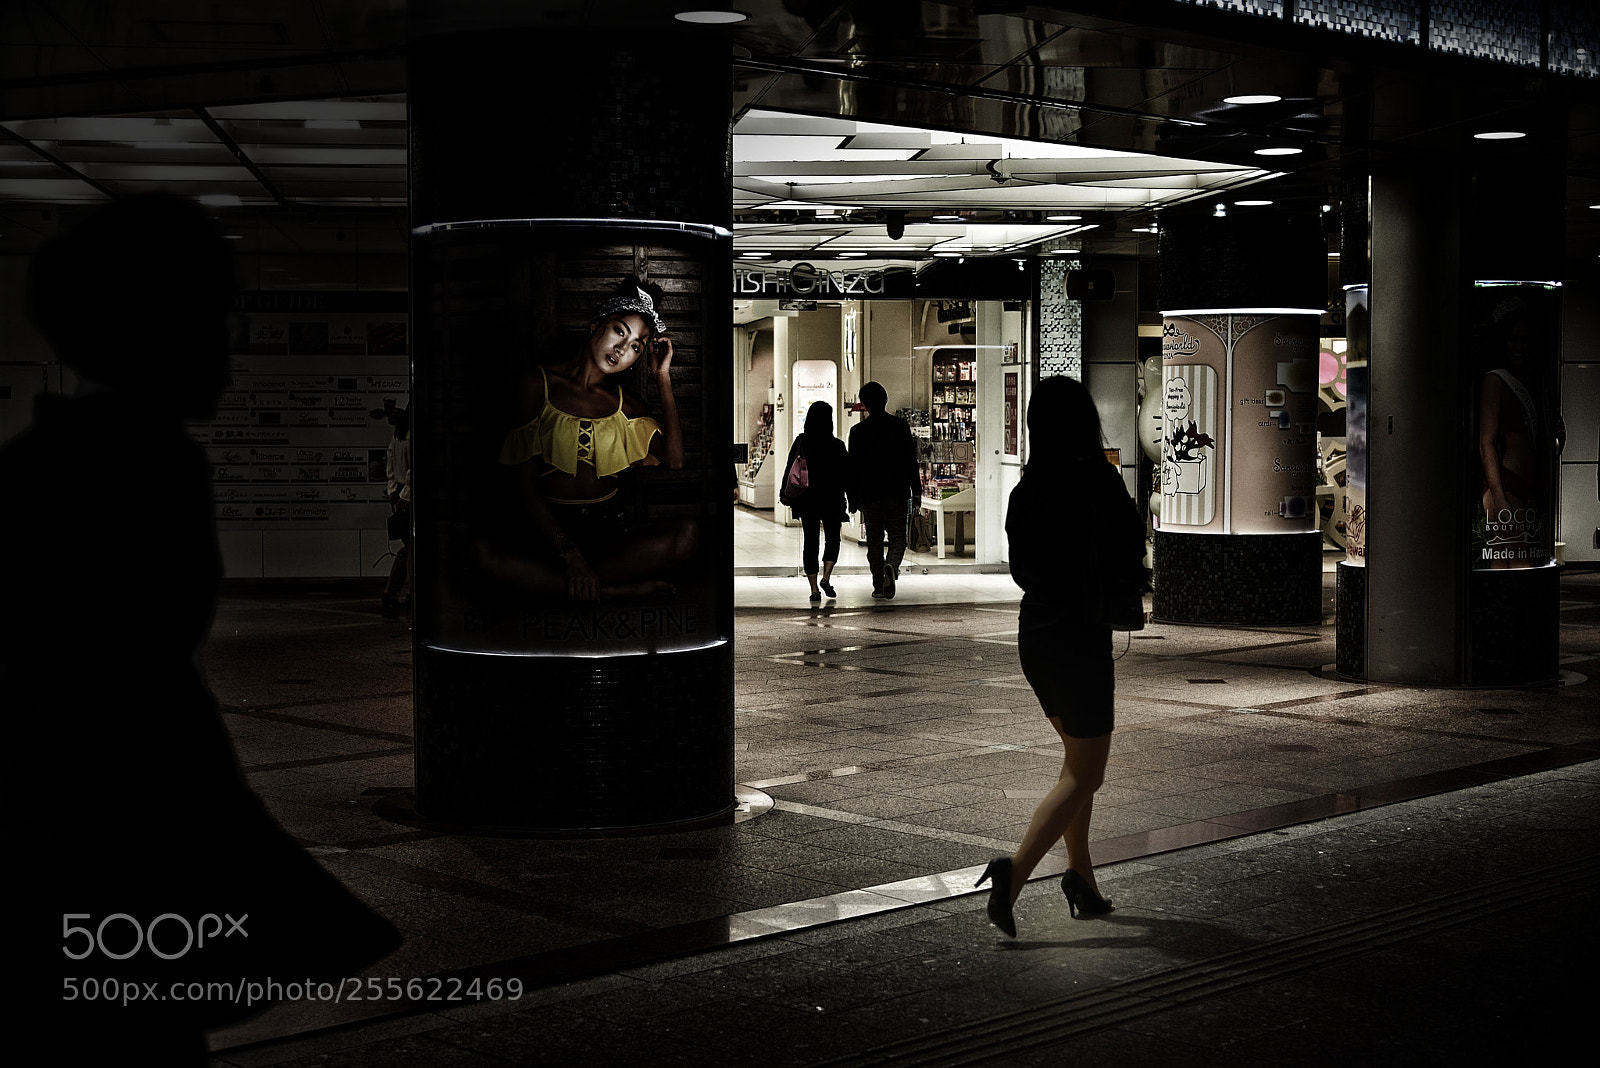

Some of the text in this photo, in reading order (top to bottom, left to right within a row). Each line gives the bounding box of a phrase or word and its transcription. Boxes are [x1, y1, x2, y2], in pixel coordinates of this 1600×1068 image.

[1486, 508, 1536, 524] LOCO
[1482, 547, 1515, 560] Made
[1518, 547, 1527, 559] in
[519, 605, 697, 641] PEAK&PINE
